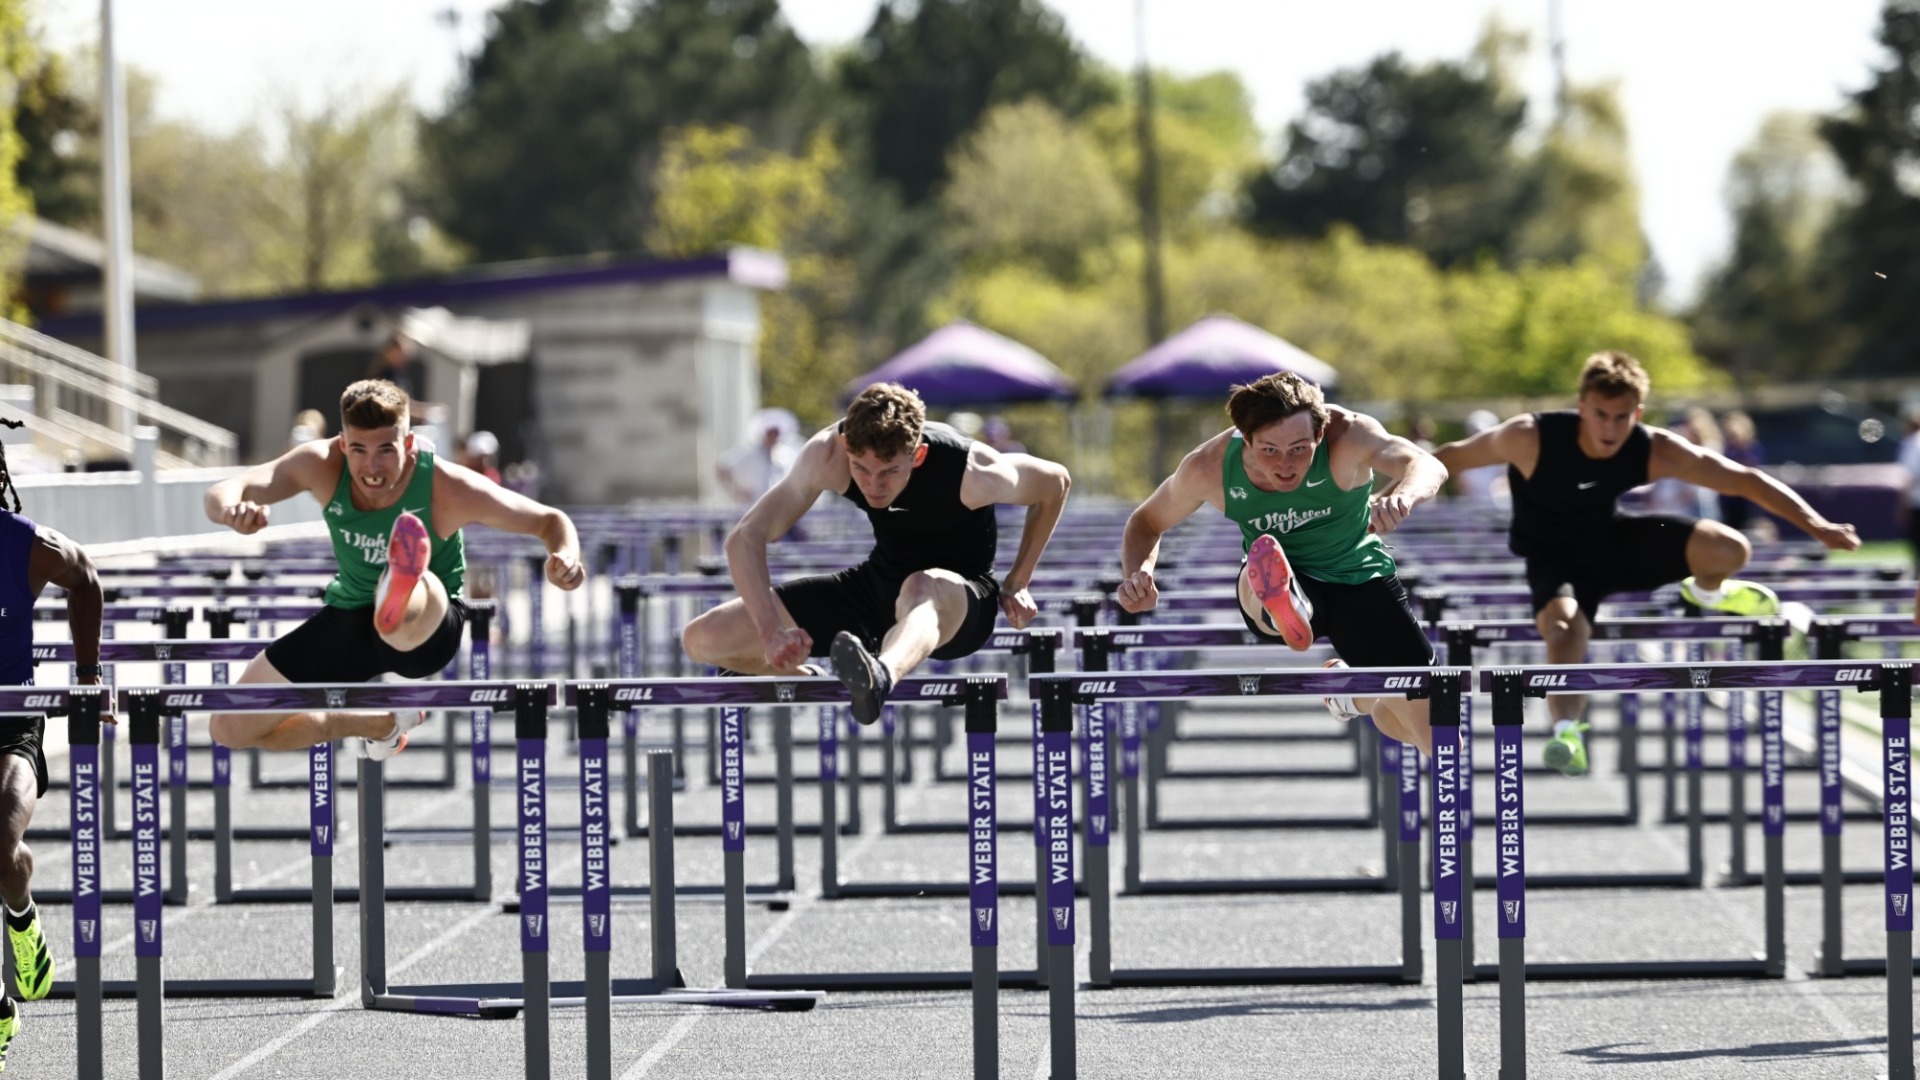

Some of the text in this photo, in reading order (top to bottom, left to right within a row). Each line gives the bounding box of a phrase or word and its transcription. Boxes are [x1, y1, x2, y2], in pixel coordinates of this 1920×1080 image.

[1248, 507, 1298, 531] Utah
[994, 635, 1024, 646] GILL
[1113, 633, 1143, 644] GILL
[615, 688, 652, 700] GILL
[921, 683, 957, 696] GILL
[1078, 681, 1116, 693] GILL
[1384, 676, 1421, 688] GILL
[1529, 674, 1567, 687] GILL
[1835, 668, 1872, 681] GILL
[24, 695, 61, 707] GILL
[166, 694, 203, 706] GILL
[470, 689, 507, 702] GILL
[725, 706, 740, 803] WEBER STAT
[1090, 742, 1104, 798] WEBER
[314, 752, 328, 808] WEBER
[973, 752, 992, 884] WEBER STATE
[1049, 751, 1069, 884] WEBER STATE
[1438, 744, 1456, 878] WEBER STATE
[1500, 744, 1519, 877] WEBER STATE
[1889, 737, 1907, 870] WEBER STATE
[77, 763, 95, 896] WEBER STATE
[136, 763, 155, 896] WEBER STATE
[523, 758, 542, 891] WEBER STATE
[585, 758, 604, 891] WEBER STATE
